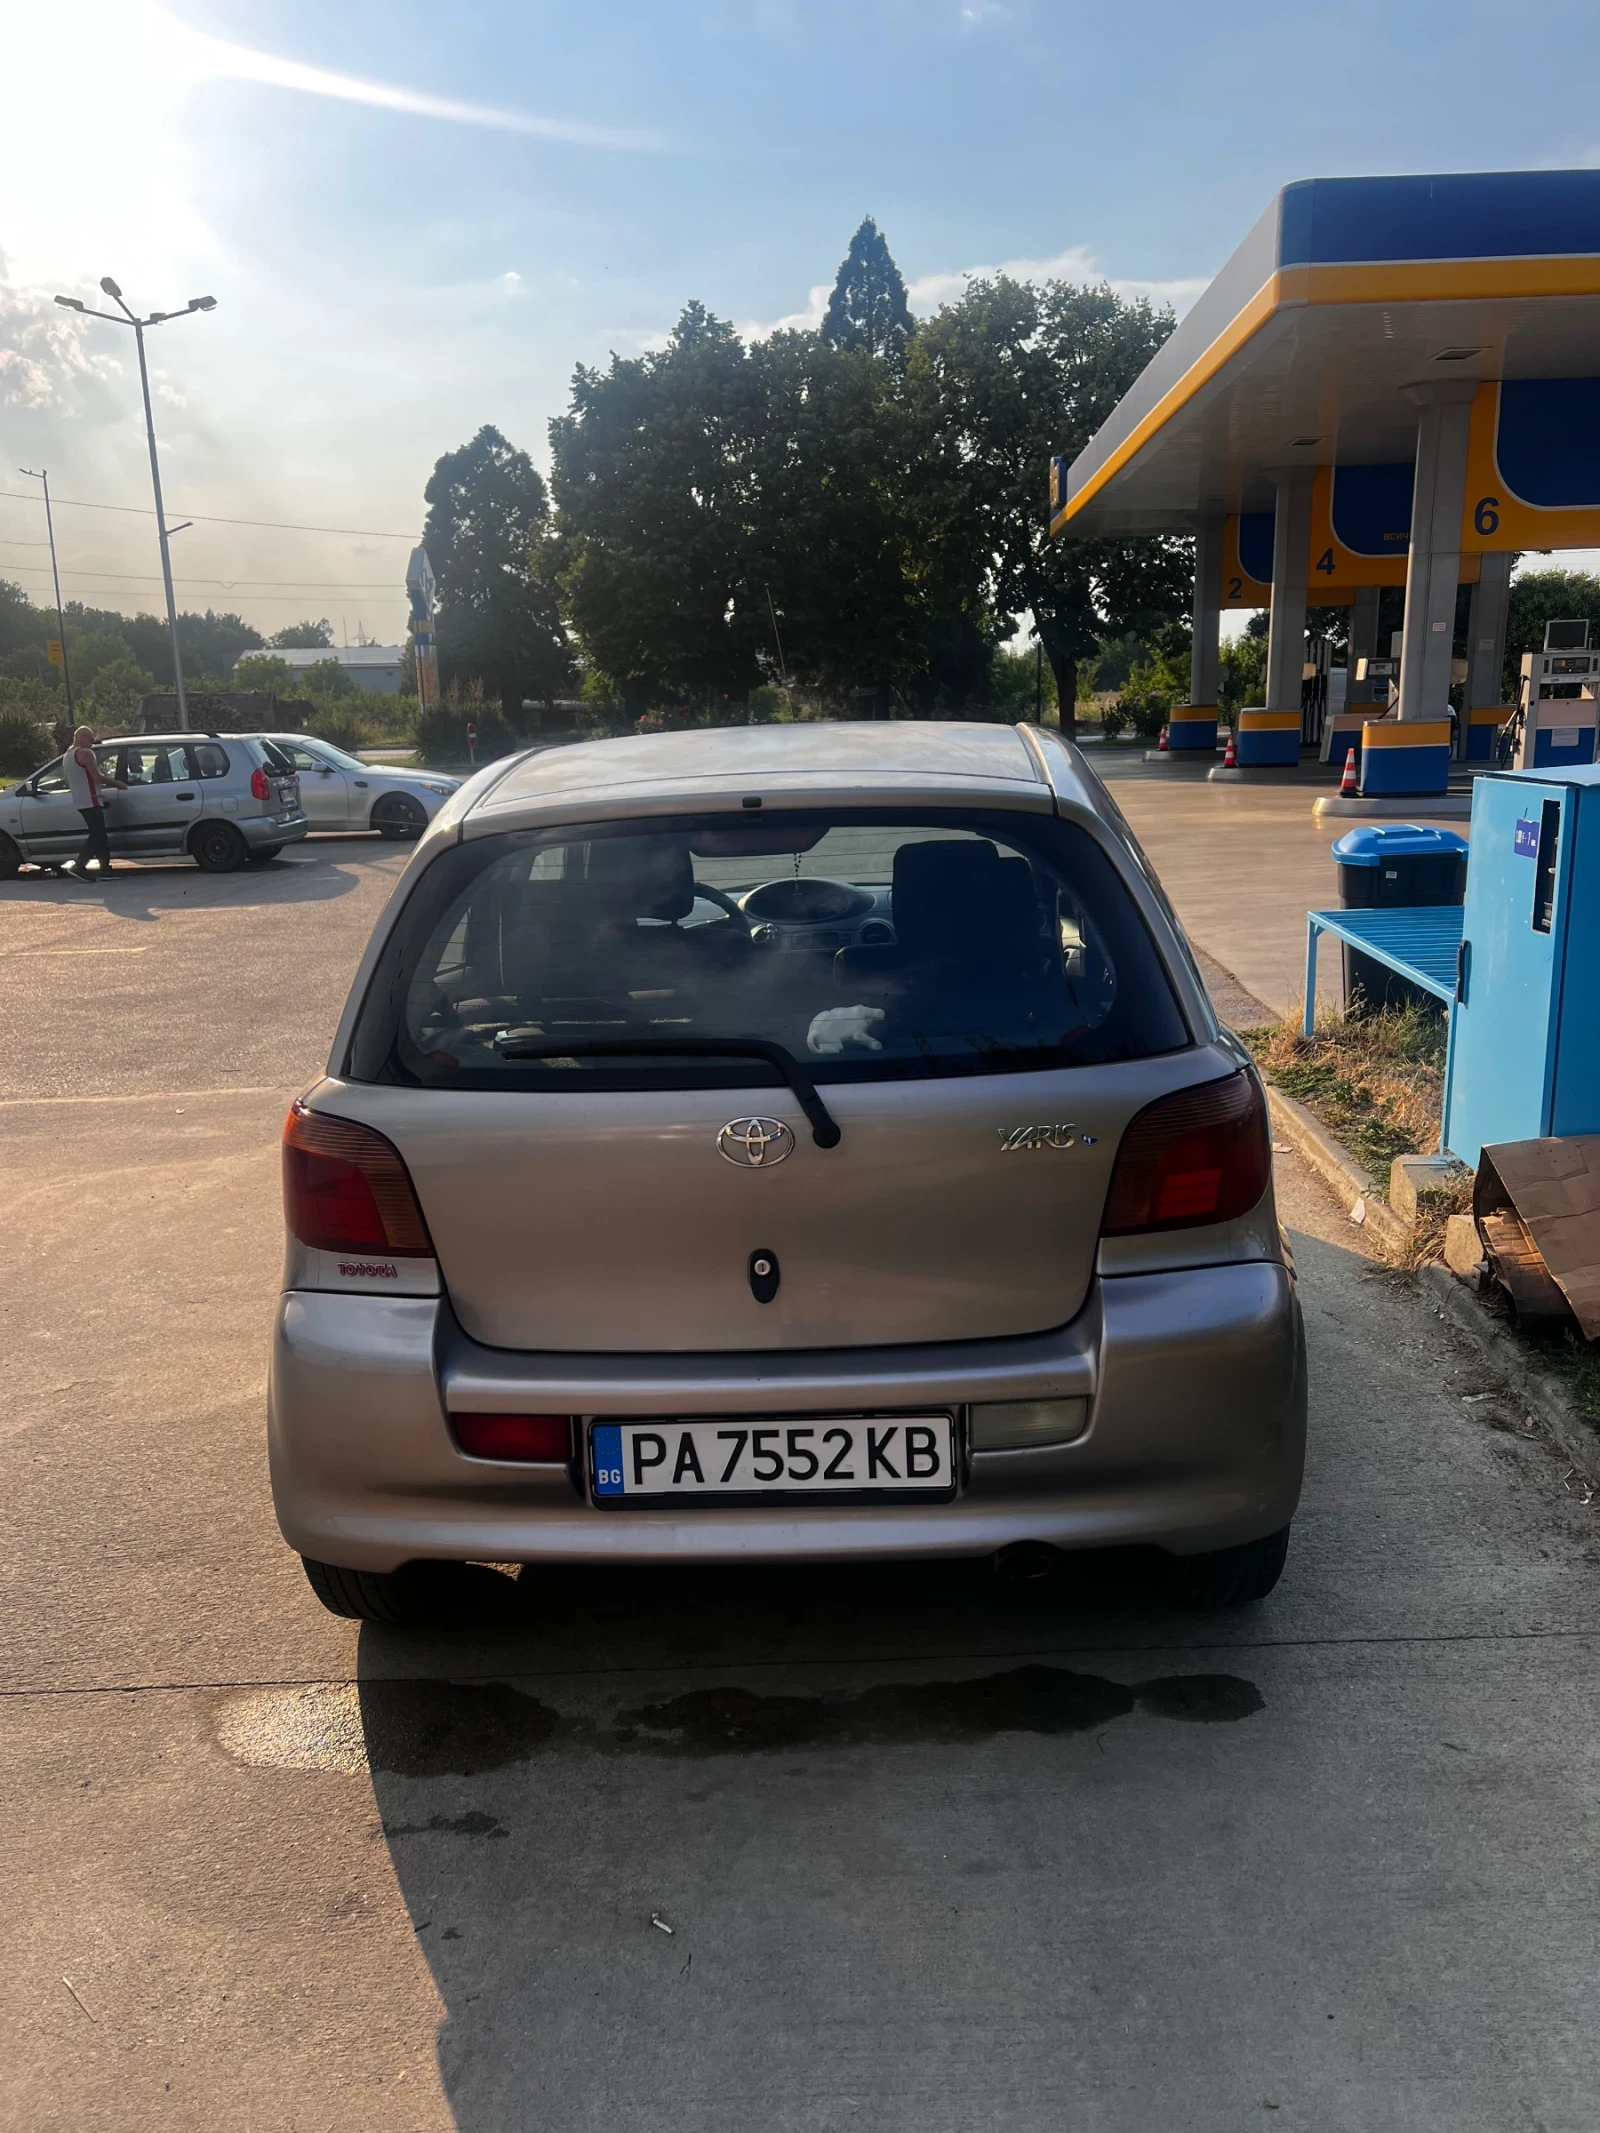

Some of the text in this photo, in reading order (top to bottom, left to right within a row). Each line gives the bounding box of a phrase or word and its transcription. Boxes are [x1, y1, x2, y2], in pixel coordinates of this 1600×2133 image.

[1474, 496, 1500, 536] 6
[1383, 532, 1410, 542] ВСИЧ
[1316, 547, 1336, 575] 4
[1227, 577, 1243, 599] 2
[997, 1123, 1077, 1151] YARIS
[337, 1262, 398, 1278] TOYOTA
[631, 1426, 940, 1485] PA 7552 KB
[598, 1469, 622, 1485] BG
